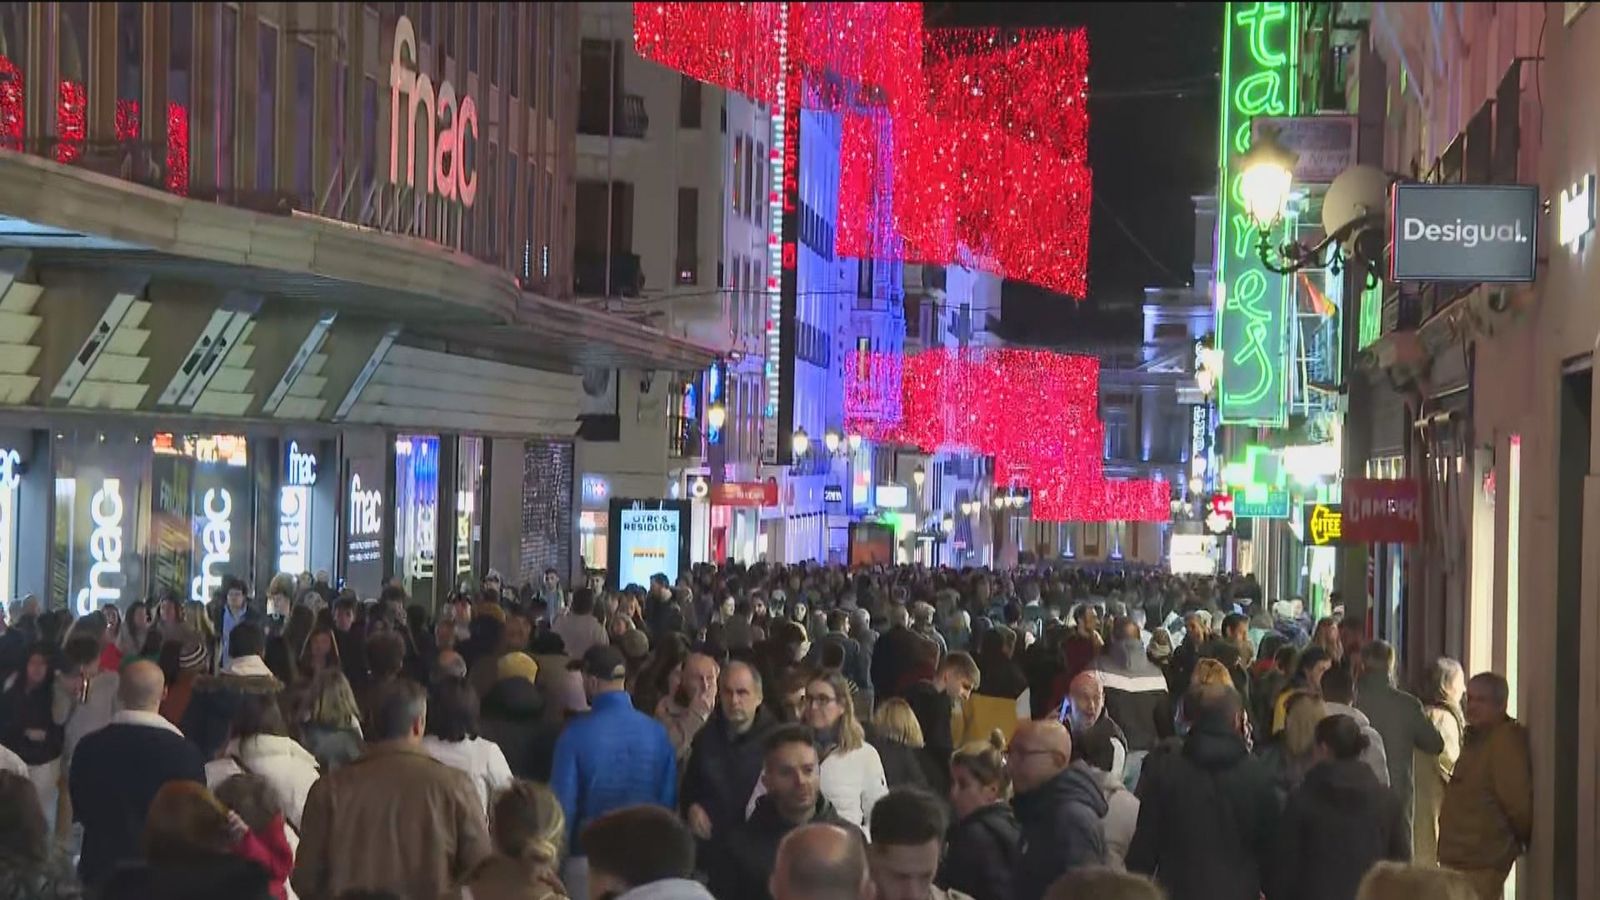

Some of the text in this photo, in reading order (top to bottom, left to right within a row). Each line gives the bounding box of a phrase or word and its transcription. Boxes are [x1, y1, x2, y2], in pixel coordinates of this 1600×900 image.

[390, 15, 478, 207] fnac
[1404, 218, 1528, 247] Desigual.
[289, 440, 317, 485] fnac
[350, 473, 381, 535] fnac
[623, 522, 677, 532] RESIDUOS
[77, 486, 124, 617] fnac
[191, 487, 232, 604] fnac
